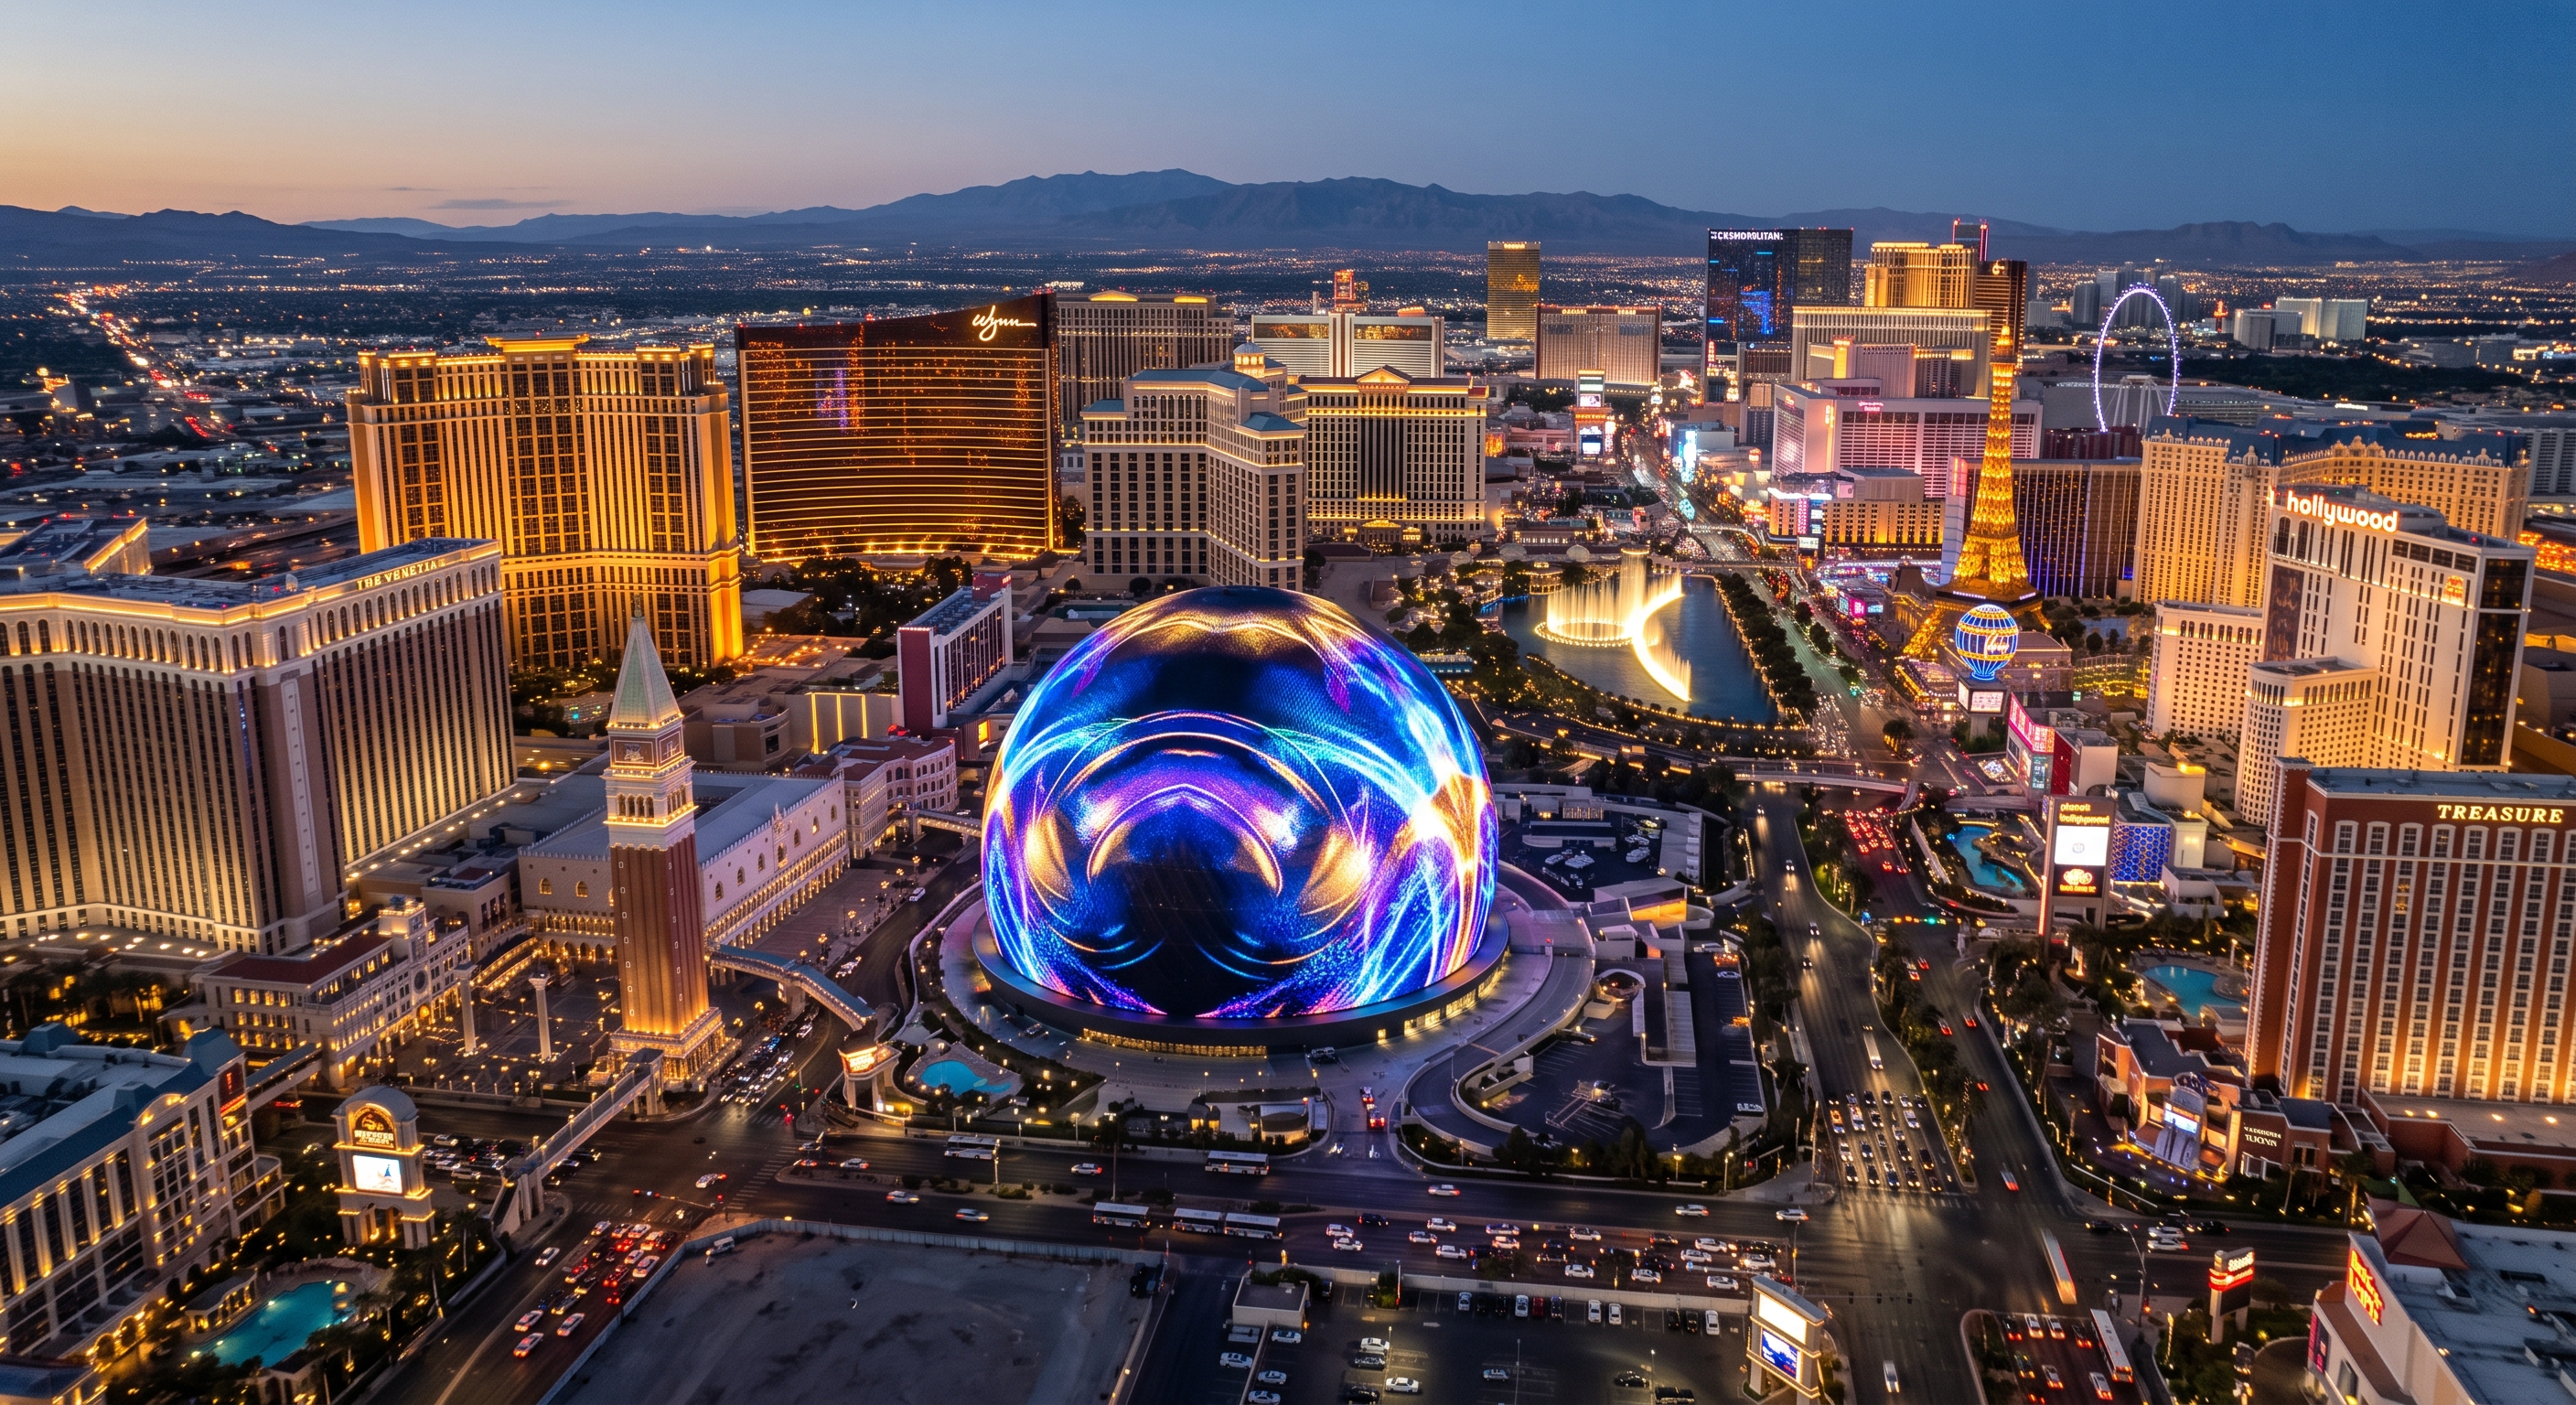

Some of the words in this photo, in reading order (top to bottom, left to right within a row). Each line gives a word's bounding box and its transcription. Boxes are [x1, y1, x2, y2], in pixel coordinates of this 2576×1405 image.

[971, 305, 1037, 342] wynn
[2287, 489, 2399, 532] hollywood
[357, 574, 381, 591] THE
[2437, 804, 2564, 823] TREASURE
